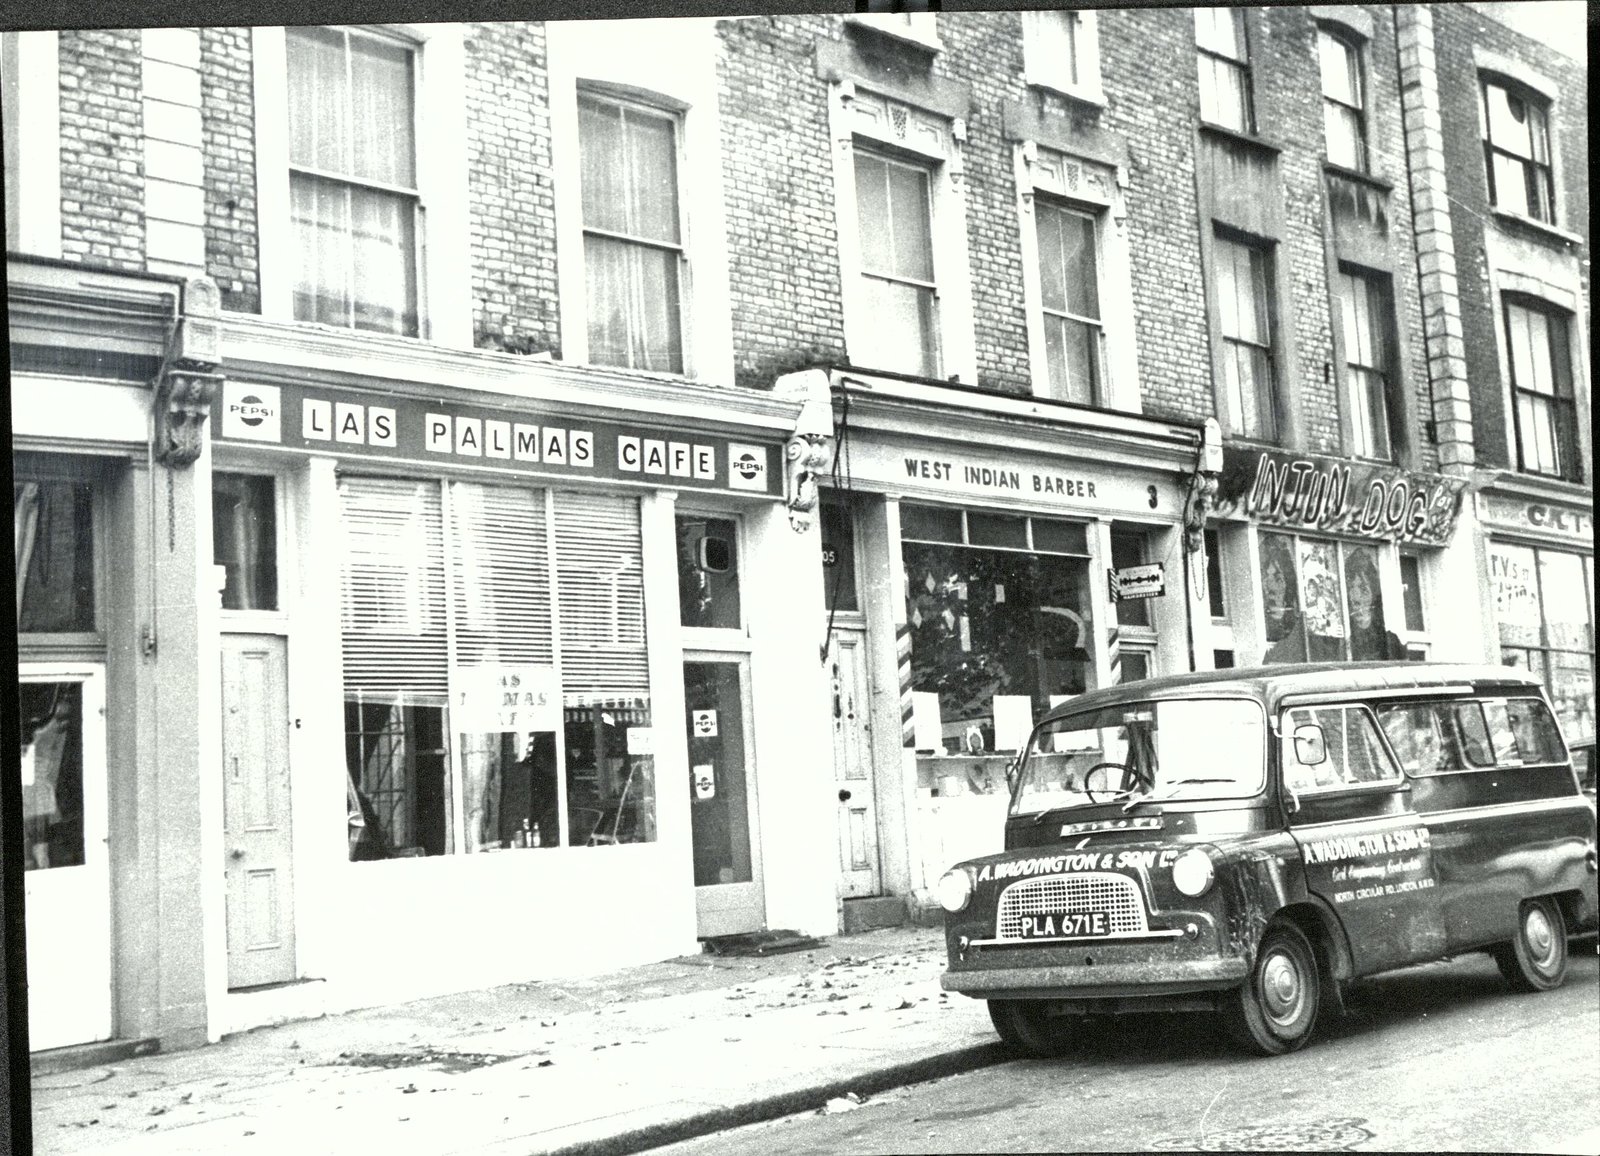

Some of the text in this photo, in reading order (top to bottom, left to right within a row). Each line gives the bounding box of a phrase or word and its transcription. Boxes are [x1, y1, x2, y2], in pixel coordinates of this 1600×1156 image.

[230, 404, 274, 417] PEPSI
[311, 408, 711, 474] LAS PALMAS CAFE
[733, 461, 764, 472] PEPSI
[904, 458, 1098, 499] WEST INDIAN BARBER
[1147, 484, 1158, 509] 3
[1360, 478, 1429, 537] DOG
[821, 549, 836, 563] 05
[1385, 834, 1395, 853] &
[1393, 829, 1419, 852] SON
[1100, 853, 1113, 869] &
[1116, 850, 1157, 869] SON
[1334, 890, 1355, 903] NORTH
[1356, 883, 1384, 900] CIRCULAR
[1021, 913, 1106, 938] PLA 671E
